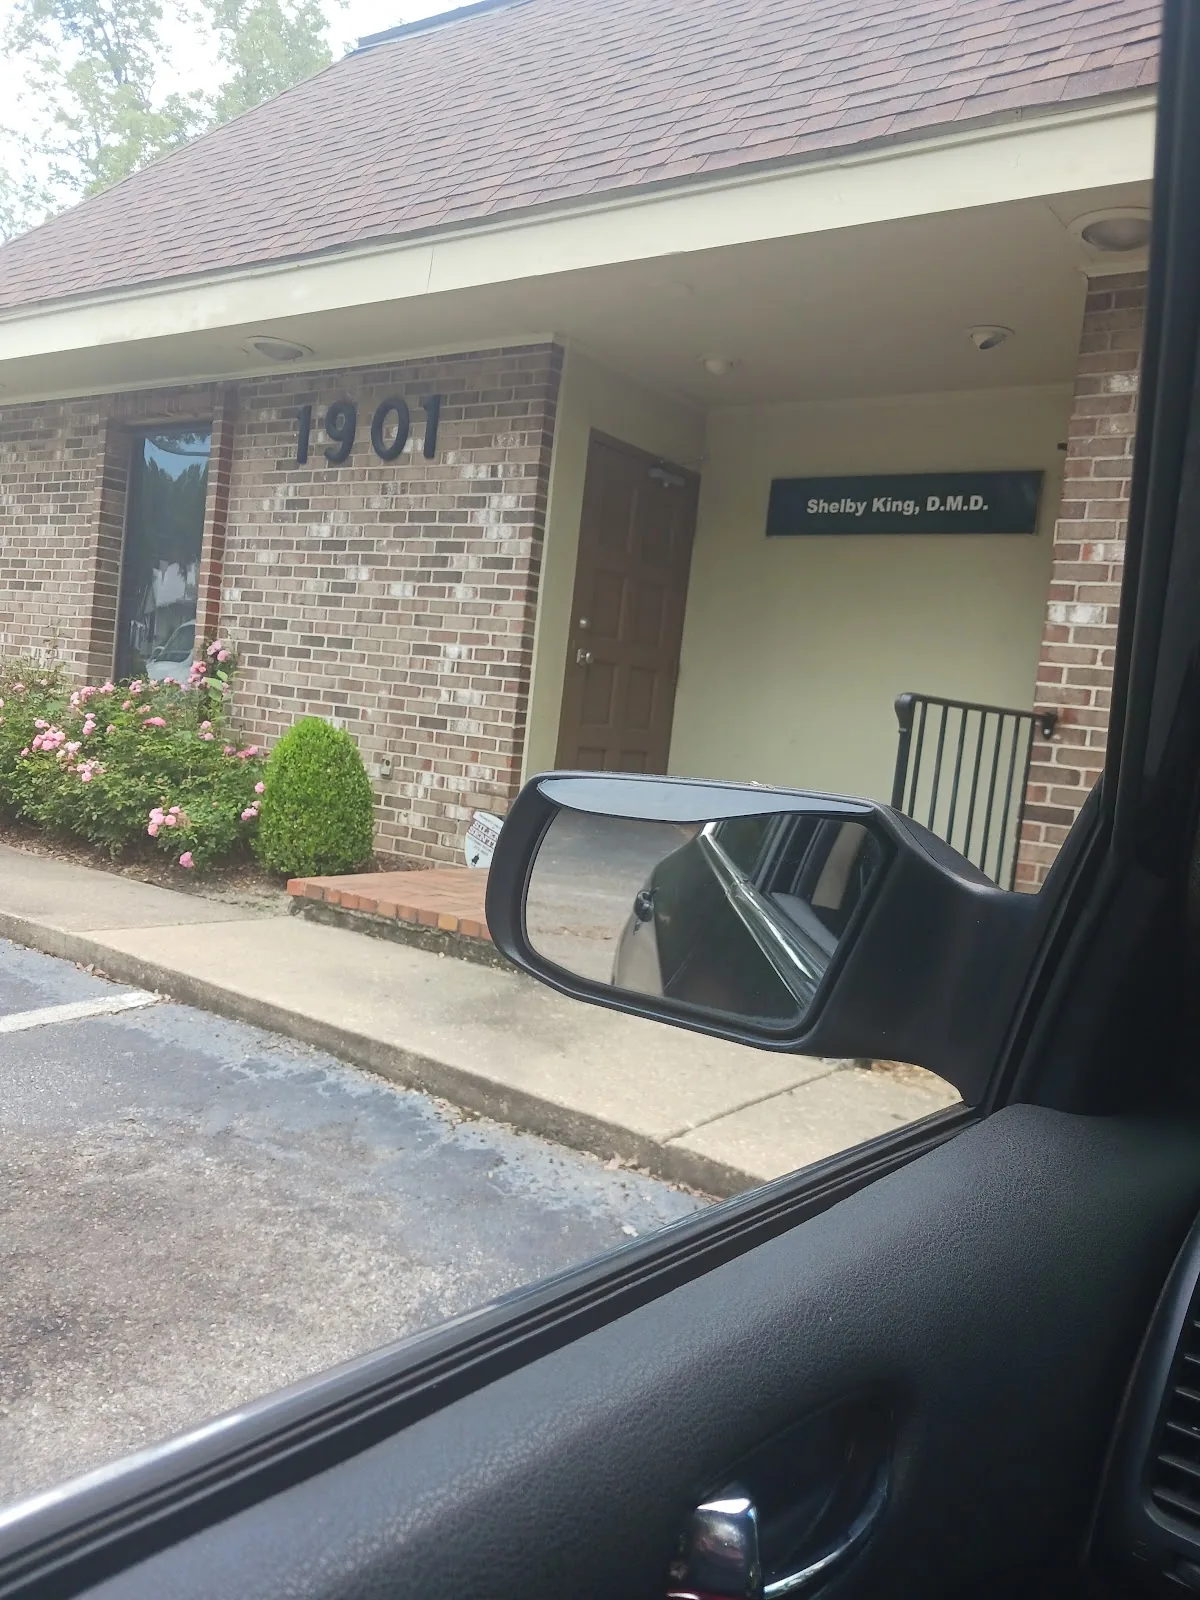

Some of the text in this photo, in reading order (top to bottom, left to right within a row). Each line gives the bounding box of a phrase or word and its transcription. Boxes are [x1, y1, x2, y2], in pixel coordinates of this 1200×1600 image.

[296, 394, 440, 465] 1901
[807, 495, 989, 516] Shelby King, D.M.D.
